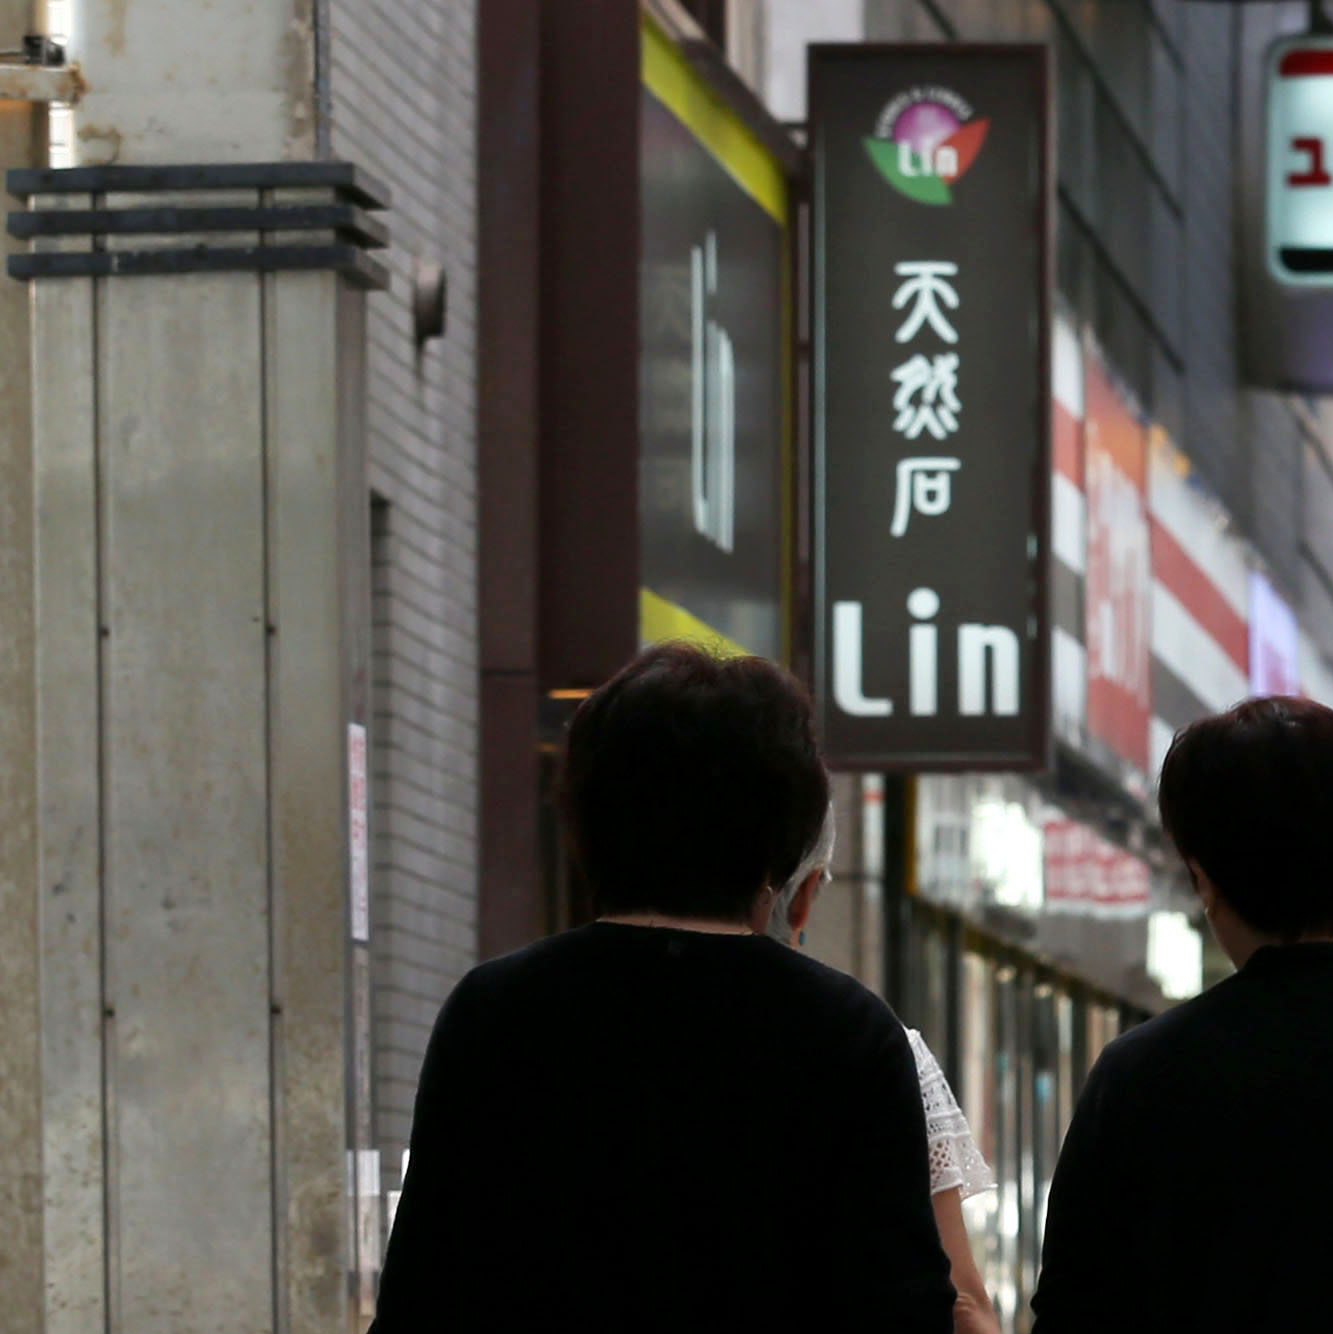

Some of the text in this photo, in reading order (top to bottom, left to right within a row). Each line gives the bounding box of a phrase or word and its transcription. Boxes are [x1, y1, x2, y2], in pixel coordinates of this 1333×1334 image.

[891, 261, 962, 538] 天然石
[832, 587, 1020, 718] Lin
